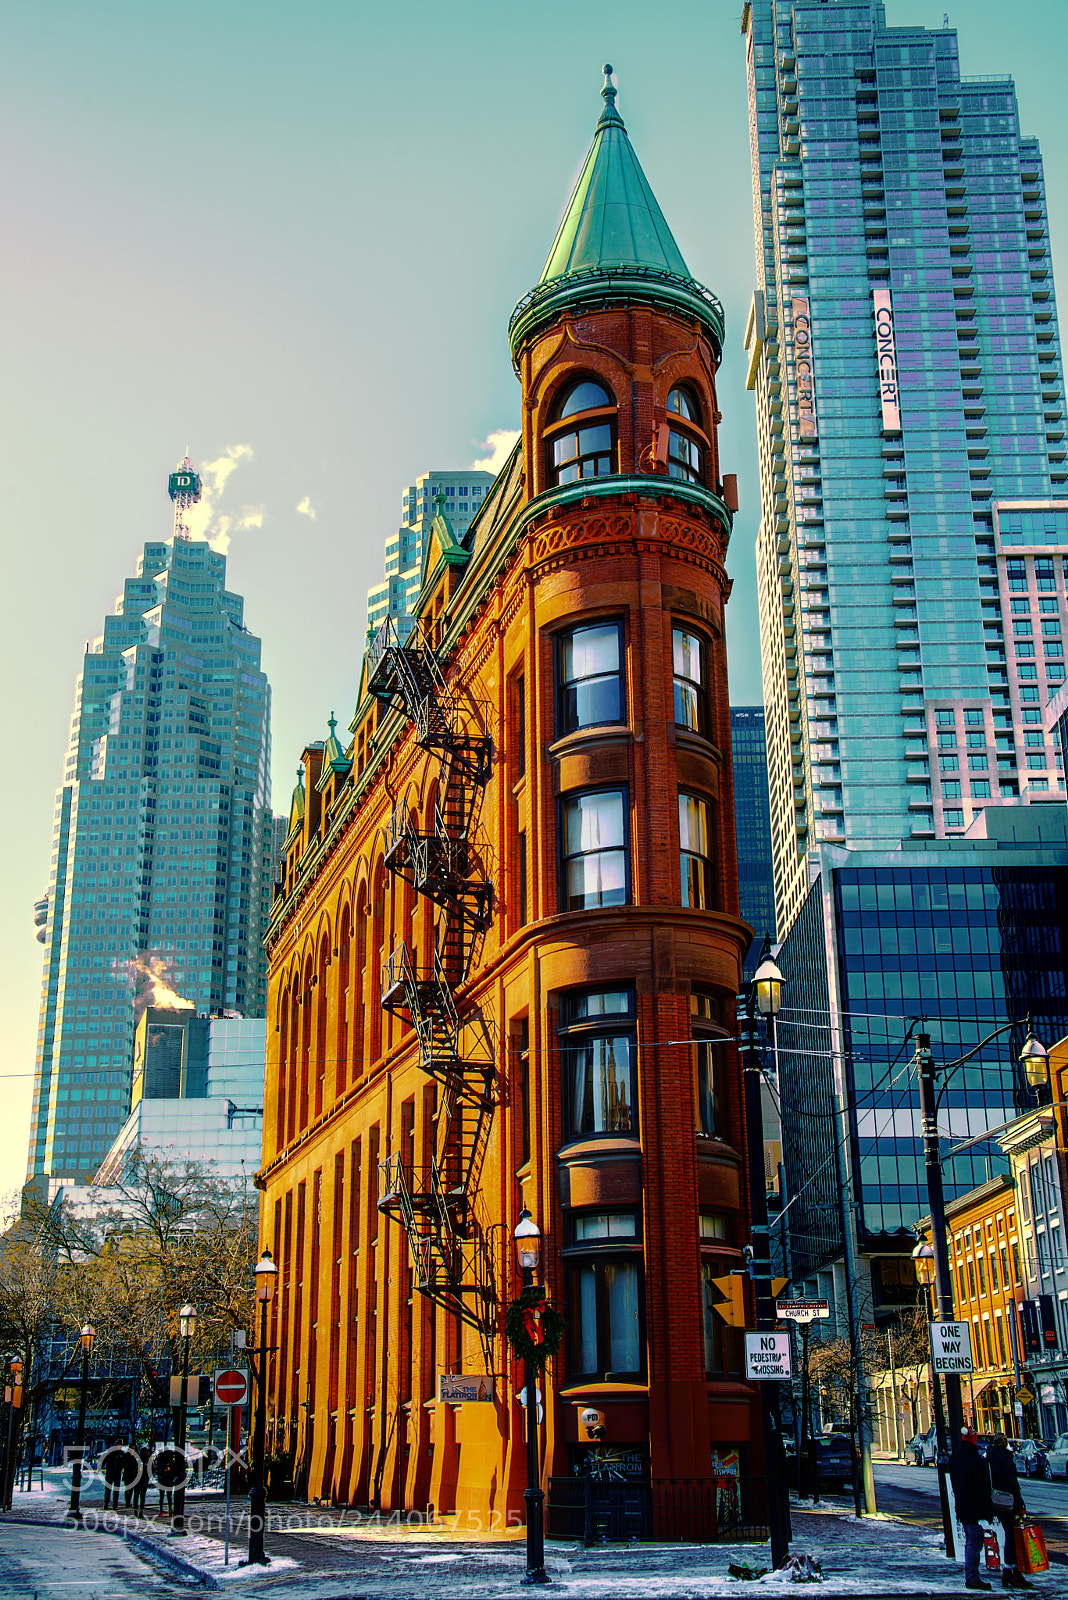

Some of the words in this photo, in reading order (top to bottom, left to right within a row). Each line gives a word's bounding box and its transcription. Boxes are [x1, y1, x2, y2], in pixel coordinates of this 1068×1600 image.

[876, 307, 897, 407] CONCERT
[794, 314, 814, 413] CONCERT
[175, 476, 191, 486] TD
[785, 1309, 809, 1317] CHURCH
[940, 1326, 960, 1337] ONE
[760, 1337, 776, 1350] NO
[942, 1341, 961, 1353] WAY
[750, 1353, 787, 1362] PEDESTRIA
[936, 1357, 971, 1369] BEGINS
[622, 1454, 642, 1462] THE
[592, 1463, 642, 1471] FLATIRON
